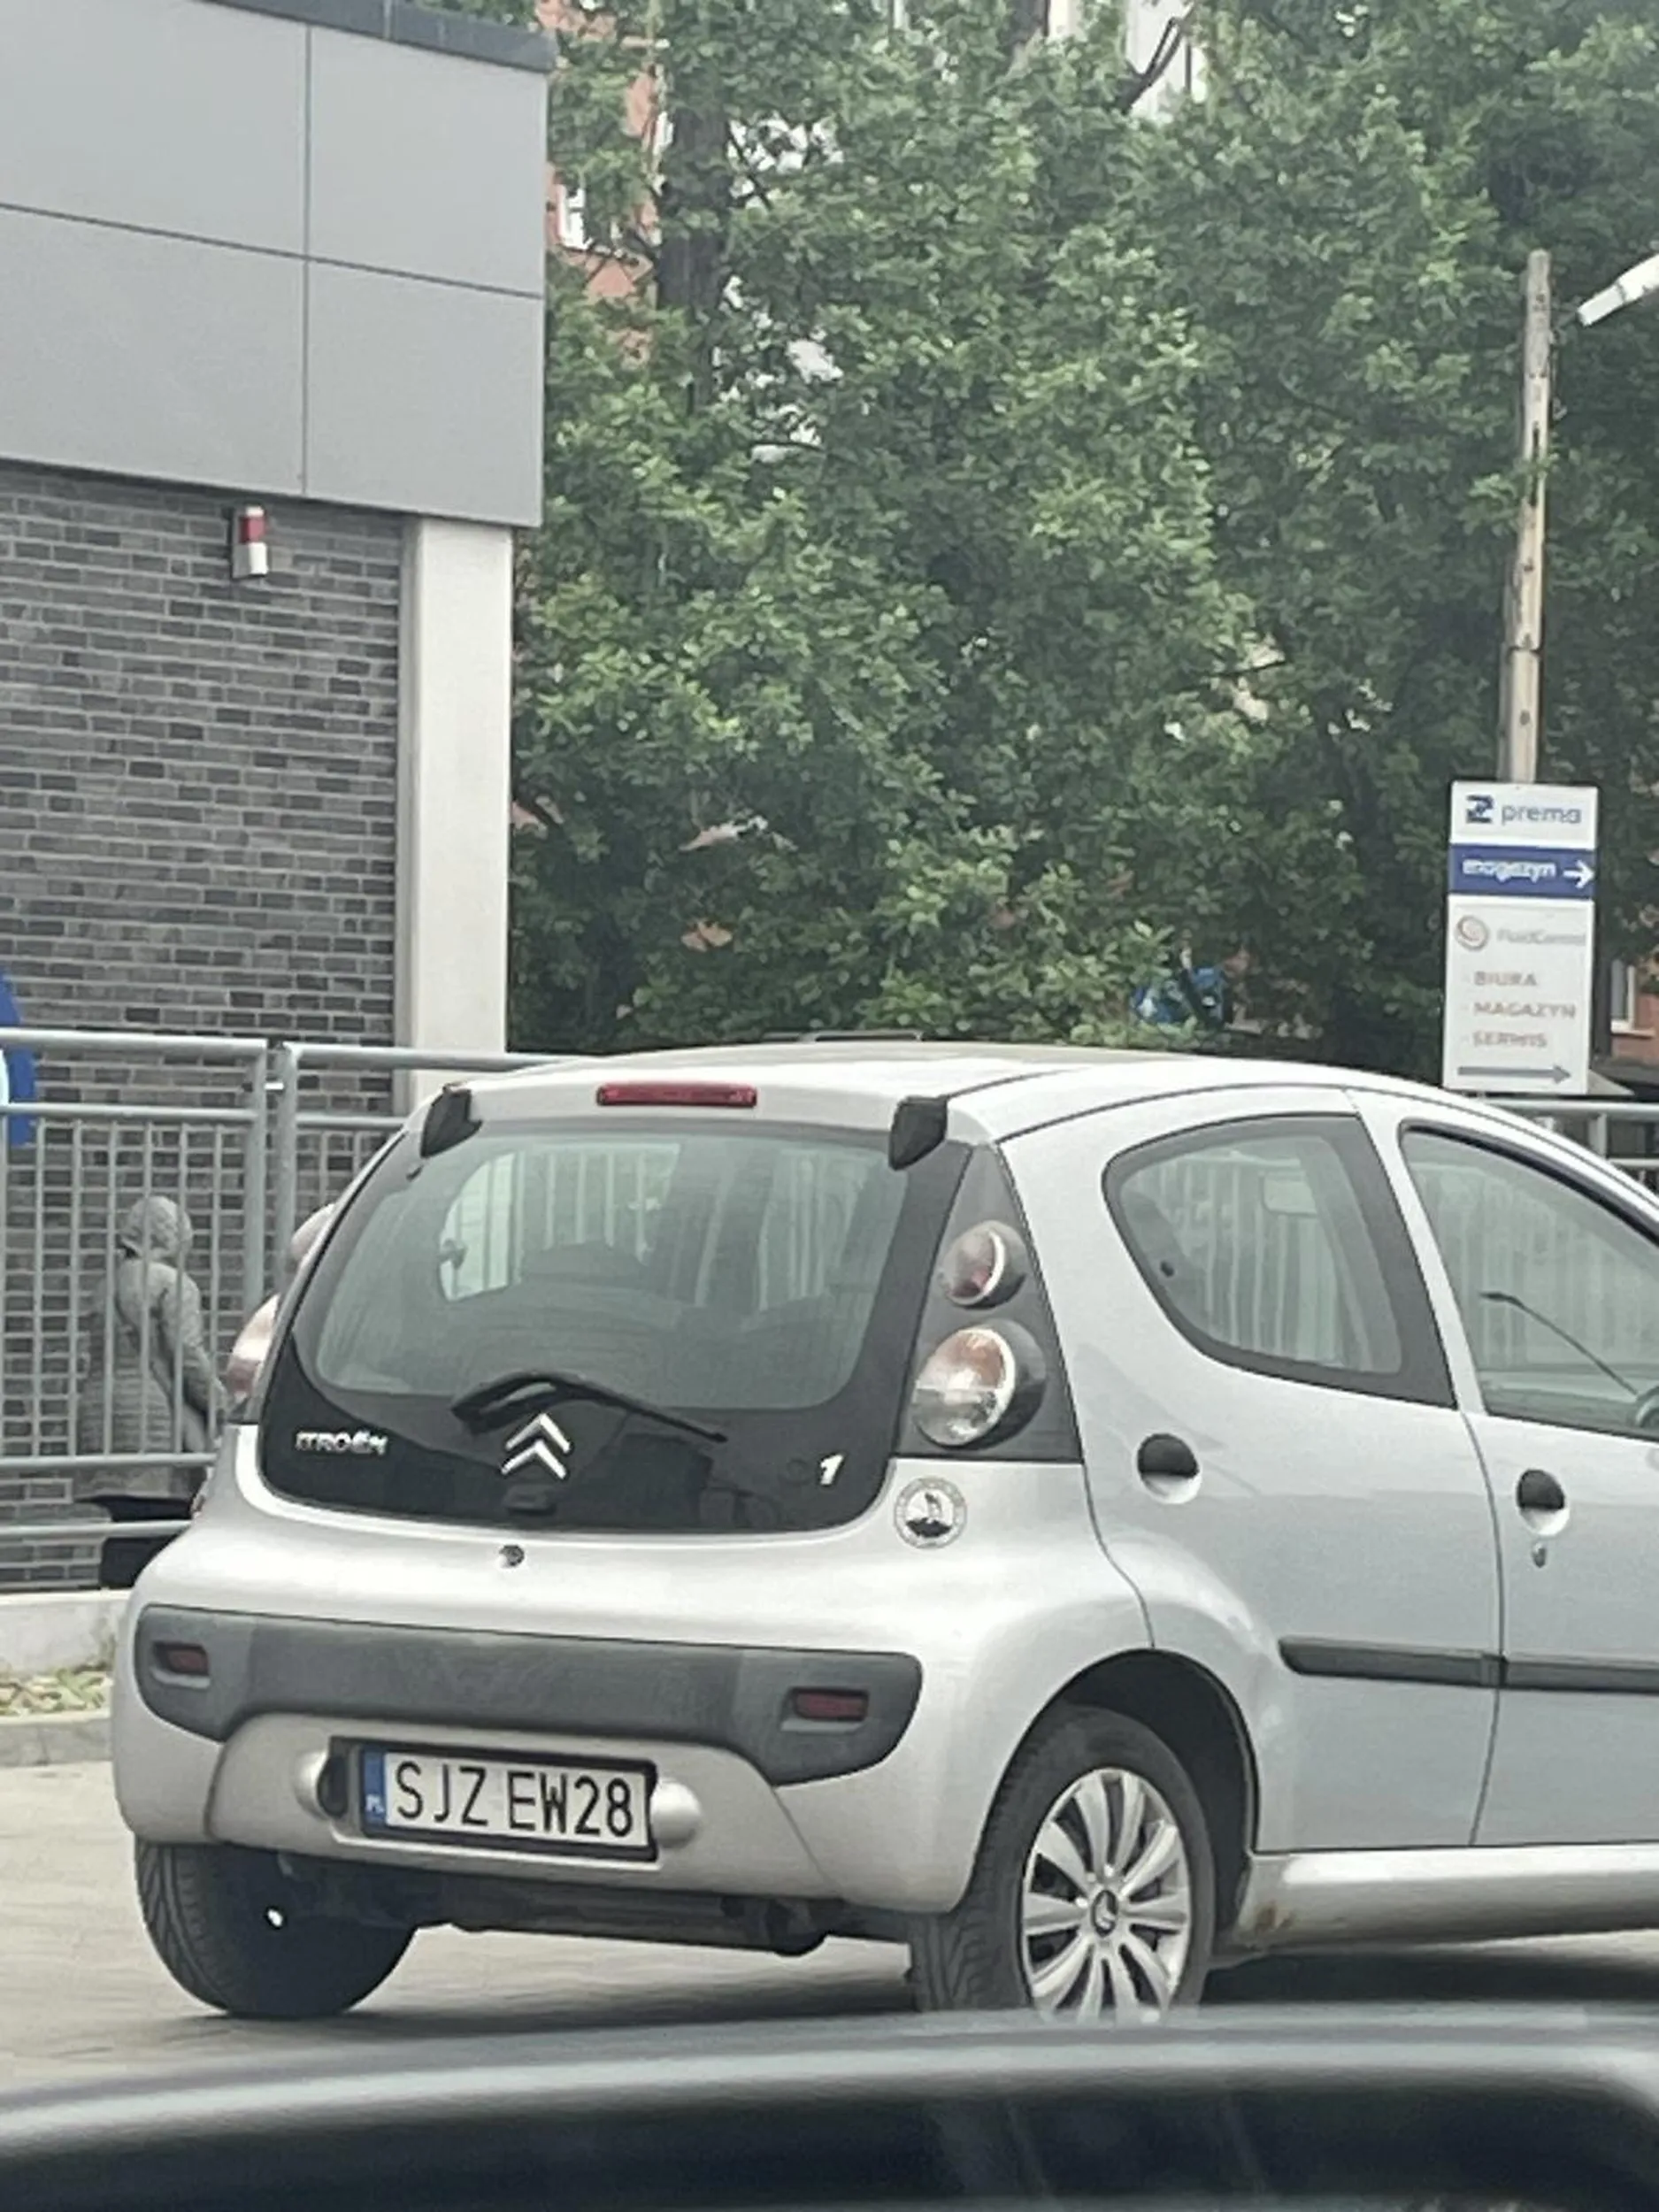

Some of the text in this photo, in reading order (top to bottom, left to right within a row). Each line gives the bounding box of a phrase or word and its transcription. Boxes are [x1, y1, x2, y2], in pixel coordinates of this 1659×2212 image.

[1502, 805, 1582, 826] prema
[1474, 971, 1538, 987] BIURA
[1474, 1001, 1576, 1019] MAGAZYN
[1472, 1030, 1548, 1048] SERWIS
[820, 1454, 843, 1485] 1
[395, 1761, 633, 1838] SJZ EW28
